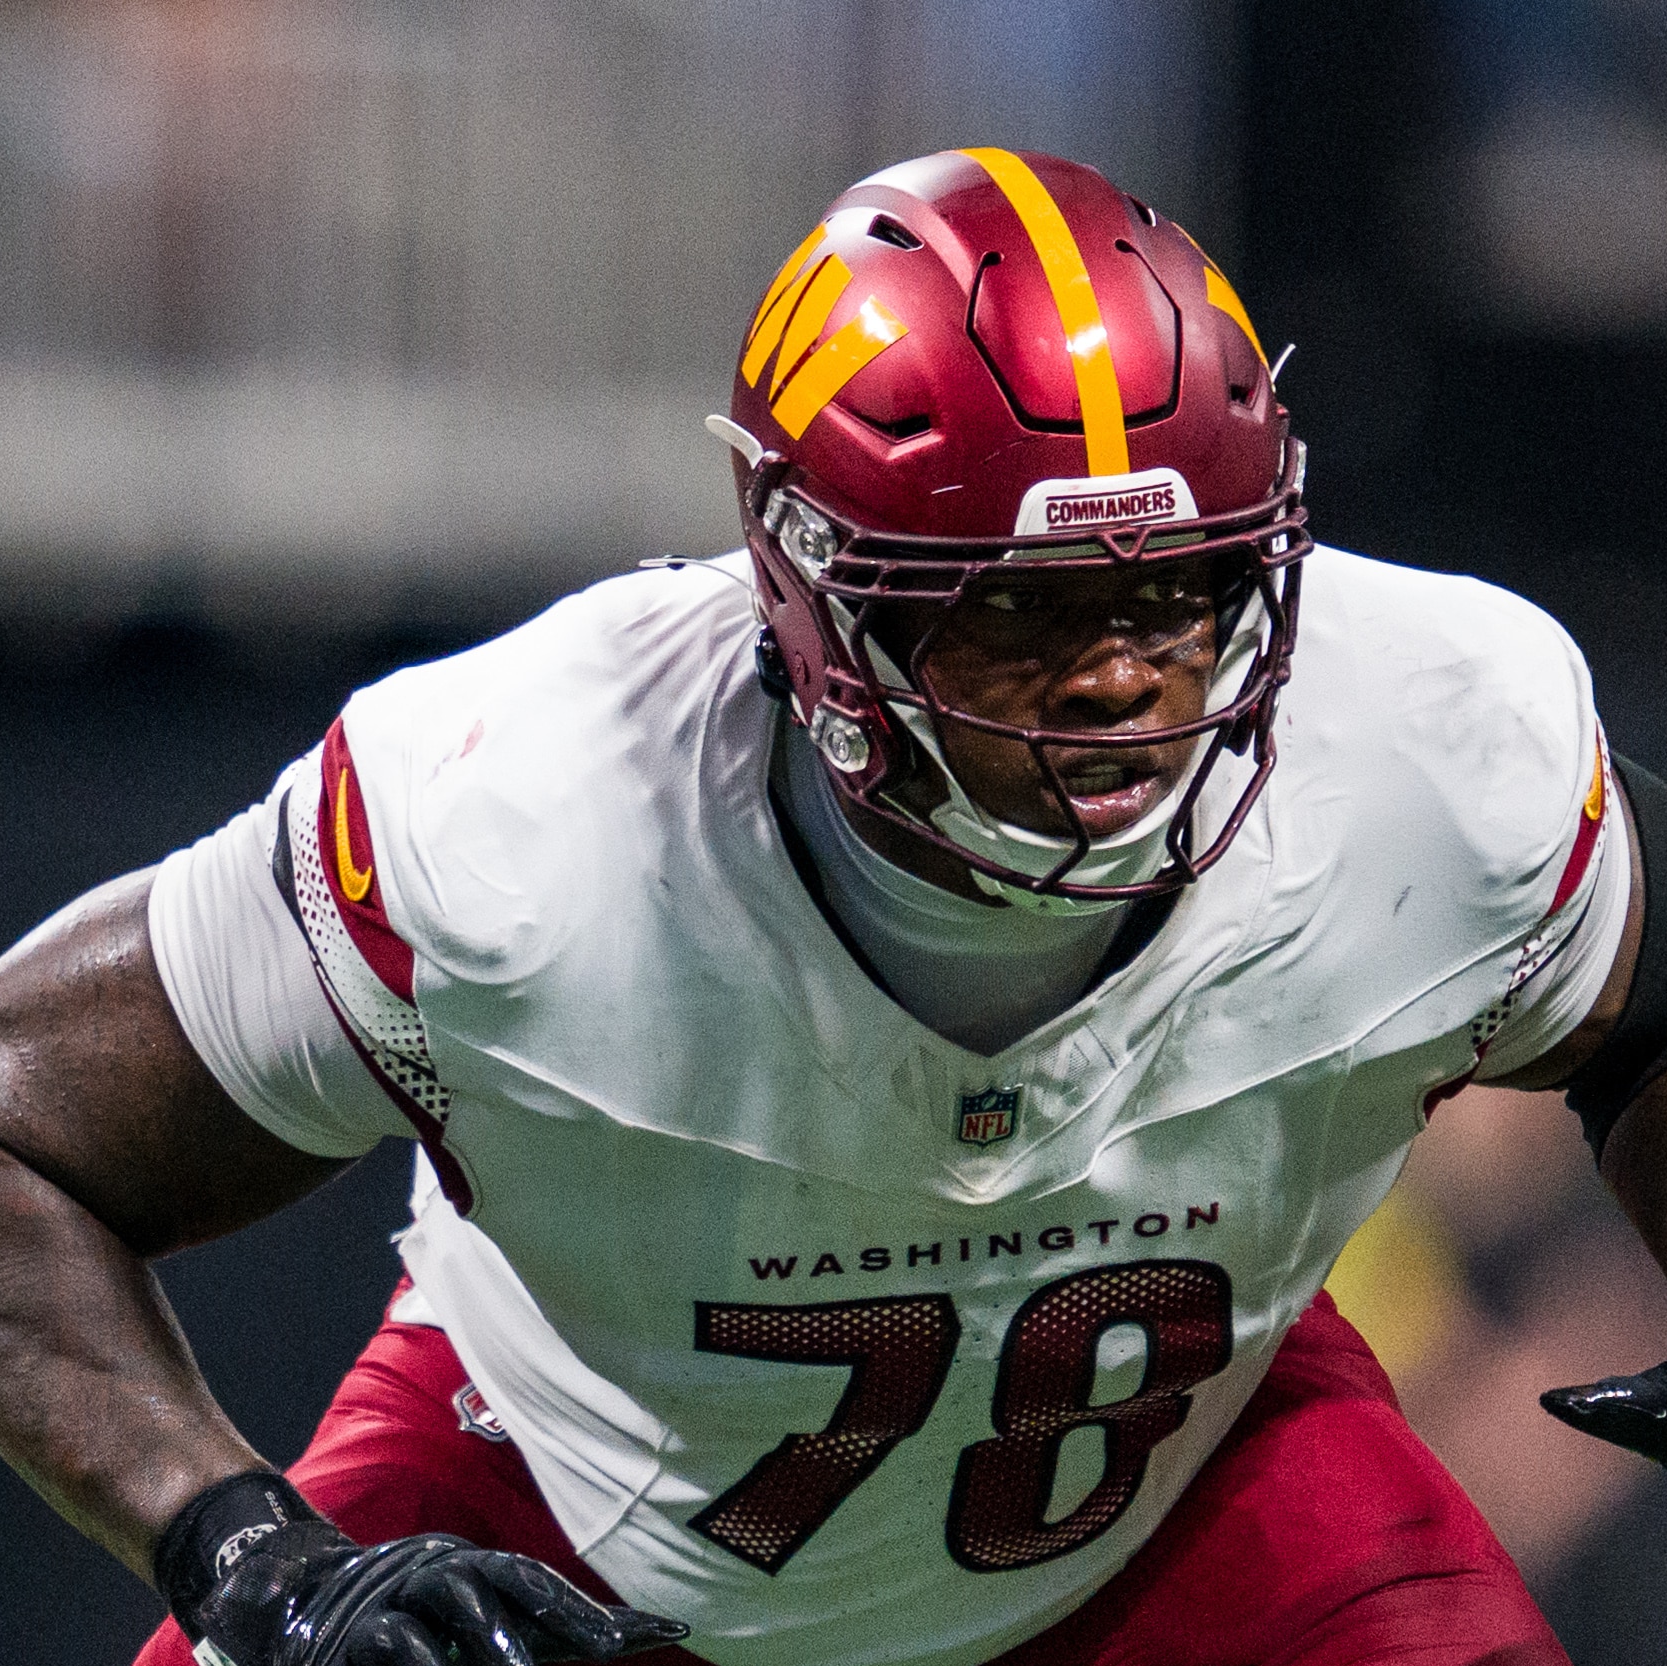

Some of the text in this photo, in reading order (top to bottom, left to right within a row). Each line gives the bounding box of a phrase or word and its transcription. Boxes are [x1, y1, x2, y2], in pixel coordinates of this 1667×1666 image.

[1046, 488, 1176, 524] COMMANDERS
[963, 1112, 1010, 1141] NFL
[748, 1201, 1221, 1281] WASHINGTON
[687, 1257, 1235, 1578] 78
